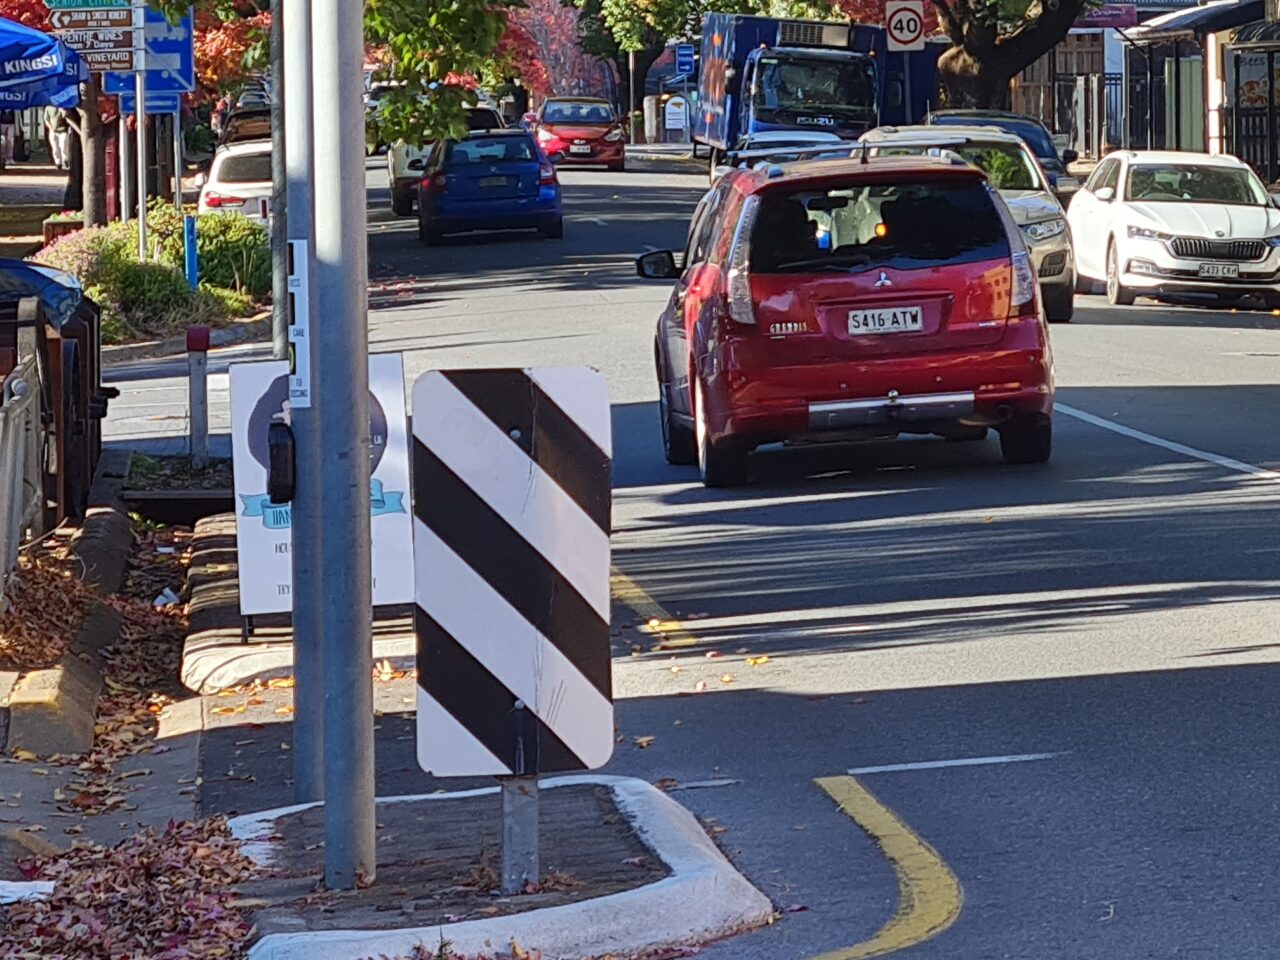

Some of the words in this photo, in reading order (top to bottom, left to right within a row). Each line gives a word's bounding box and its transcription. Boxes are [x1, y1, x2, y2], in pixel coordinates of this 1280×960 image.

[893, 18, 918, 34] 40
[98, 30, 123, 40] WINES
[94, 41, 114, 50] Days
[86, 52, 129, 62] VINEYARD
[796, 116, 835, 127] ISUZU
[852, 311, 885, 329] S416
[891, 309, 919, 327] ATW
